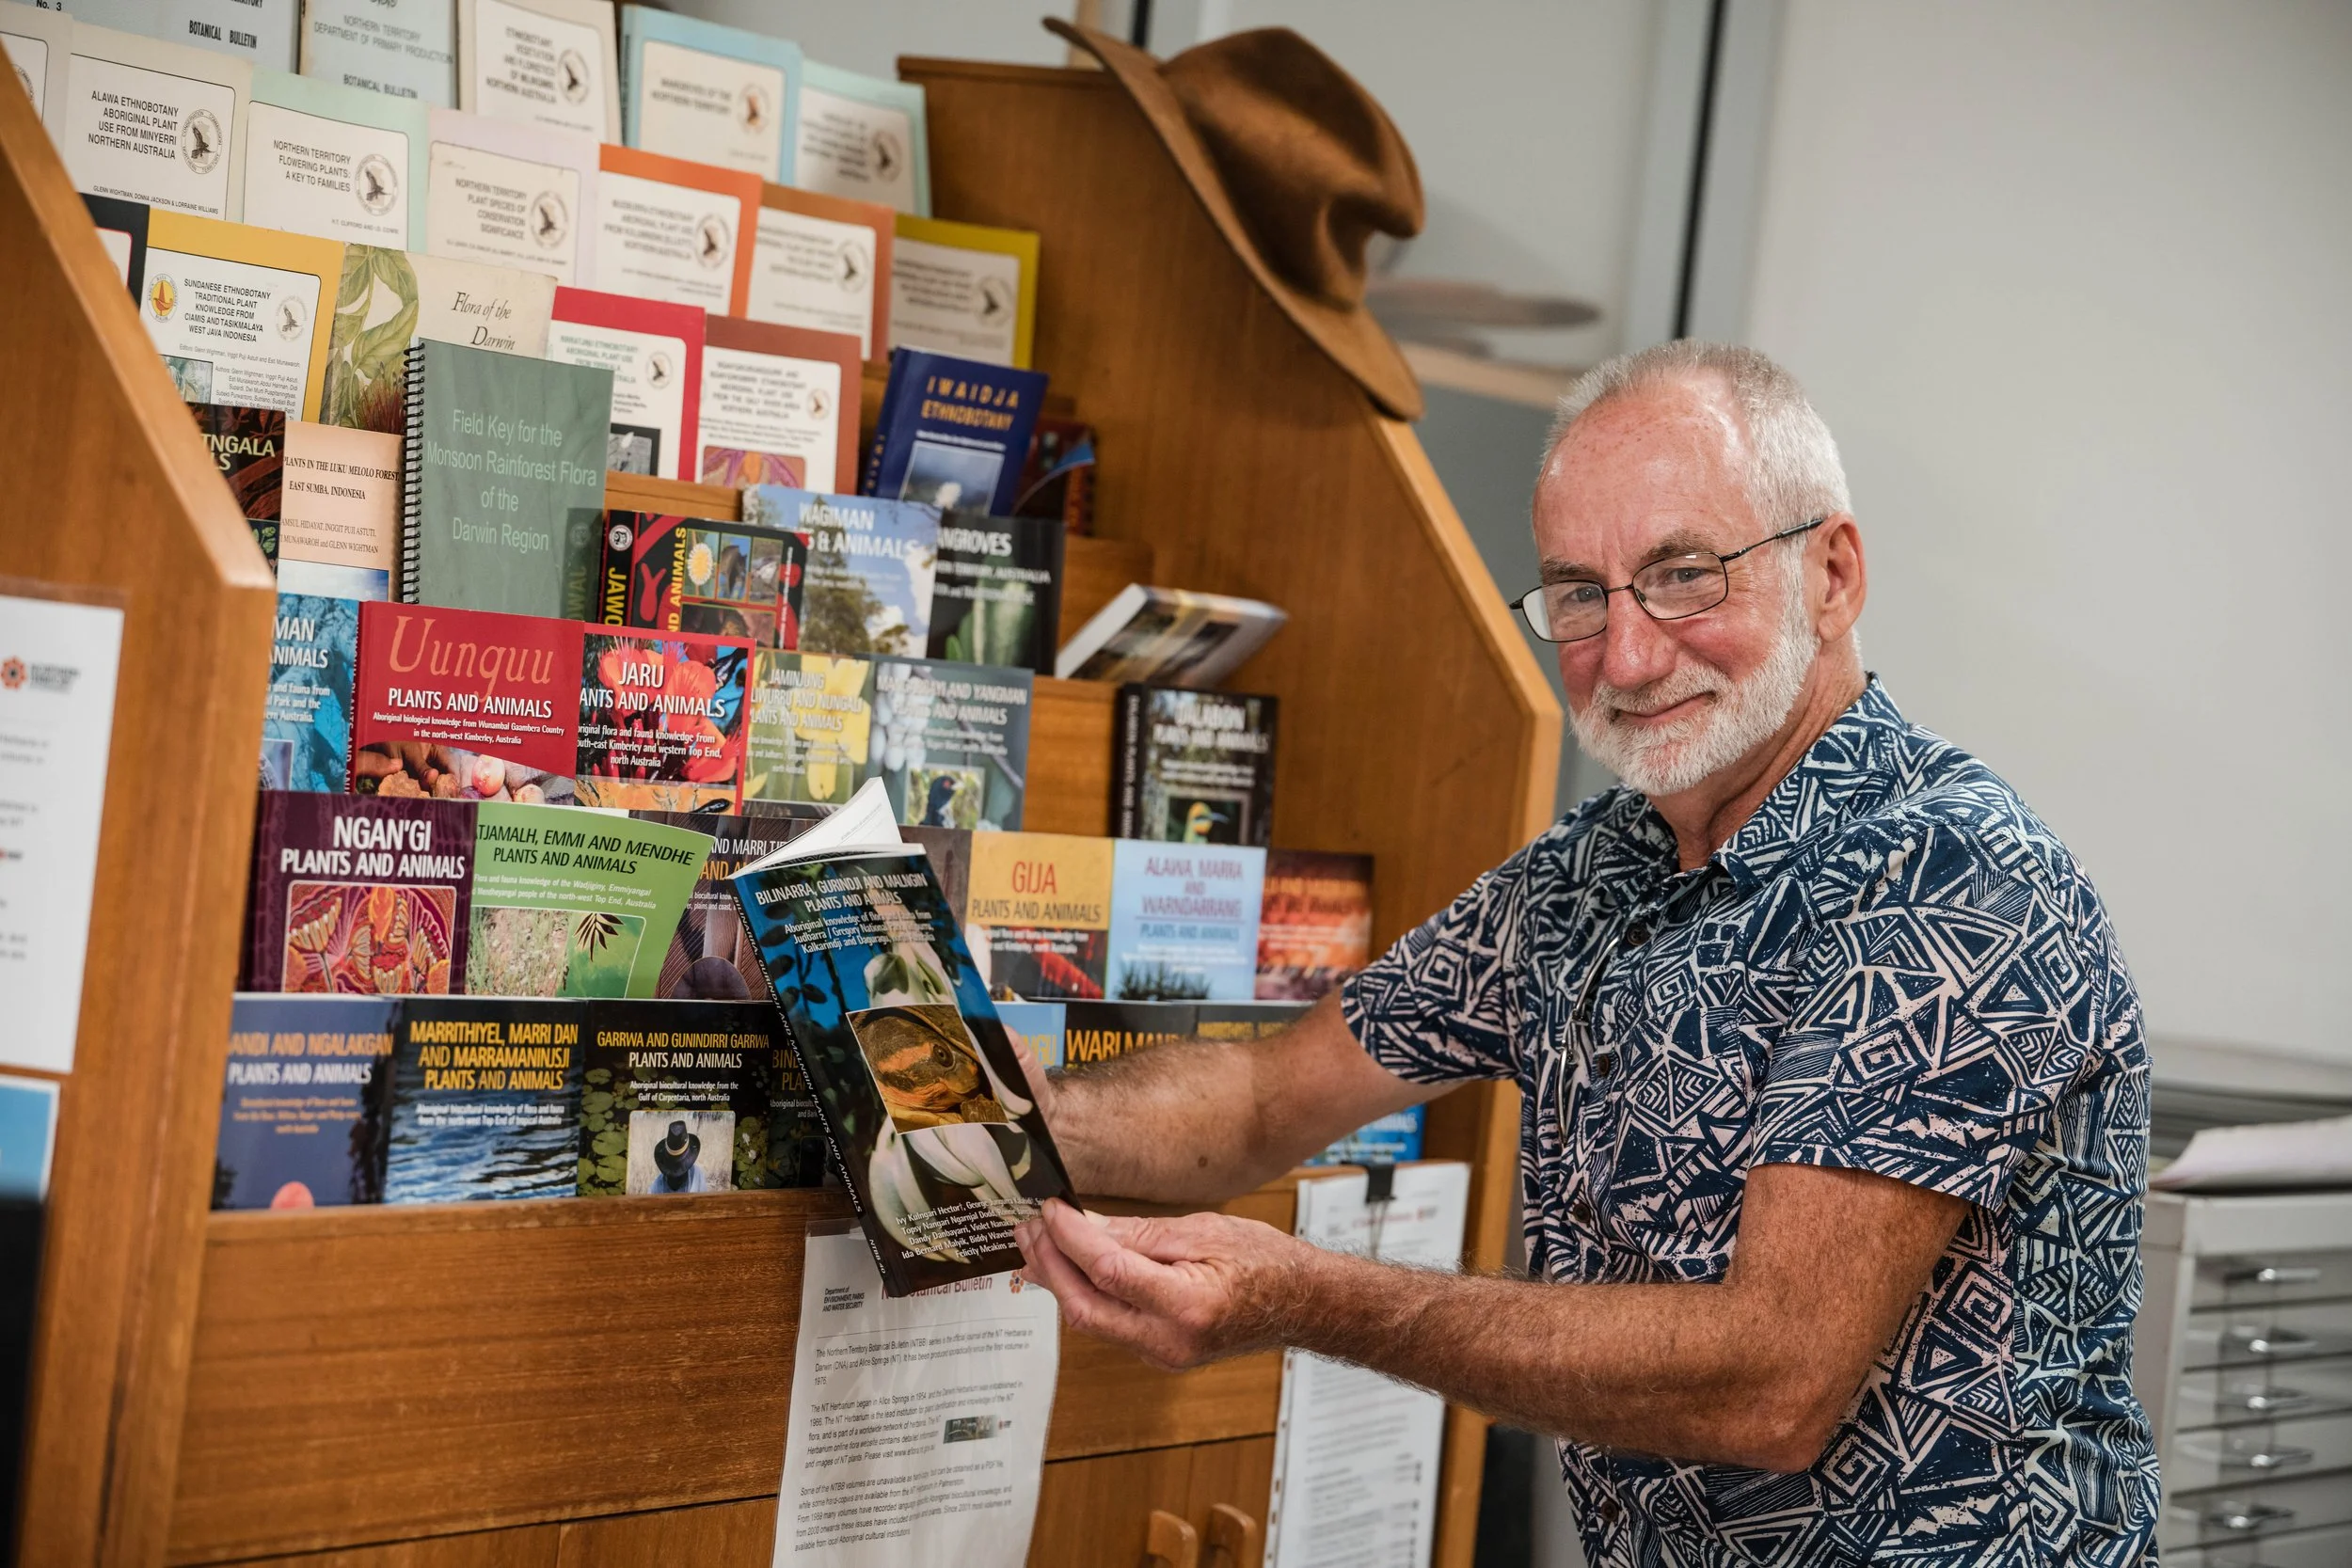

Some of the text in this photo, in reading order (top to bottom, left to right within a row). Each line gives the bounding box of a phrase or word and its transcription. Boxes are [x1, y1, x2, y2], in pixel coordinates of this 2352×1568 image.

[56, 2, 61, 10] 3
[343, 15, 380, 32] NORTHERN
[189, 21, 257, 48] BOTANICAL BULLETIN
[343, 73, 418, 99] BOTANICAL BULLETIN
[92, 91, 179, 117] ALAWA ETHNOBOTANY
[103, 107, 178, 131] ABORIGINAL PLANT
[88, 134, 176, 159] NORTHERN AUSTRALIA
[140, 130, 177, 145] MINYERRI
[274, 140, 351, 165] NORTHERN TERRITORY
[279, 155, 317, 172] FLOWERING
[317, 178, 350, 192] FAMILIES
[455, 179, 527, 199] NORTHERN TERRITORY
[151, 196, 170, 205] JACKSON
[176, 199, 197, 210] LORRAINE
[468, 194, 488, 203] PLANT
[477, 210, 526, 226] CONSERVATION
[184, 278, 271, 299] SUNDANESE ETHNOBOTANY
[195, 292, 257, 309] TRADITIONAL PLANT
[452, 292, 511, 321] Flora of the
[196, 305, 234, 317] KNOWLEDGE
[223, 331, 257, 342] INDONESIA
[470, 325, 516, 351] Darwin
[927, 375, 1019, 409] IWAIDJA
[921, 400, 1015, 431] ETHNOBOTANY
[453, 409, 562, 448] Field Key for the
[316, 460, 348, 474] THE LUKU
[427, 441, 596, 487] Monsoon Rainforest Flora
[289, 481, 365, 500] EAST INDONESIA
[481, 486, 518, 512] of the
[453, 517, 548, 554] Darwin Region
[818, 531, 918, 560] & ANIMALS
[670, 527, 687, 607] ANIMALS
[389, 615, 554, 702] Uunguu
[619, 661, 664, 688] JARU
[770, 668, 825, 689] JAMINJUNG
[289, 683, 330, 696] fauna from
[389, 688, 551, 719] PLANTS AND ANIMALS
[618, 691, 725, 718] AND ANIMALS
[373, 712, 564, 736] Aboriginal biological knowledge Country
[801, 715, 843, 732] ANIMALS
[958, 705, 1008, 725] ANIMALS
[432, 730, 463, 740] north-west
[656, 729, 693, 743] knowledge
[609, 740, 642, 753] Kimberley
[611, 755, 661, 767] north Australia
[333, 816, 433, 852] NGAN'GI
[544, 830, 695, 866] EMMI AND MENDHE
[280, 848, 465, 879] PLANTS AND ANIMALS
[494, 847, 637, 875] PLANTS AND ANIMALS
[1011, 861, 1057, 894] GIJA
[755, 873, 928, 906] BILINARRA, GURINDJI AND MALNGIN
[626, 898, 656, 909] Australia
[804, 895, 863, 913] PLANTS AND
[1042, 903, 1102, 923] ANIMALS
[785, 918, 823, 935] Aboriginal
[802, 937, 857, 954] Kalkarindji and
[410, 1021, 579, 1047] MARRITHIYEL, MARRI DAN
[597, 1031, 769, 1049] GARRWA GUNINDIRRI GARRWA
[308, 1033, 394, 1056] NGALAKGAN
[418, 1045, 451, 1067] AND
[628, 1052, 742, 1069] PLANTS AND ANIMALS
[313, 1063, 373, 1085] ANIMALS
[424, 1069, 564, 1090] PLANTS AND ANIMALS
[812, 1094, 863, 1213] PLANTS AND ANIMALS
[908, 1210, 938, 1223] Kulngari
[924, 1212, 978, 1231] Nangari Ngarnjal
[969, 1234, 988, 1244] Biddy
[955, 1243, 1008, 1259] Felicity Meakins
[825, 1287, 844, 1295] Department
[954, 1276, 993, 1293] Bulletin
[832, 1303, 845, 1311] WATER
[817, 1349, 826, 1358] The
